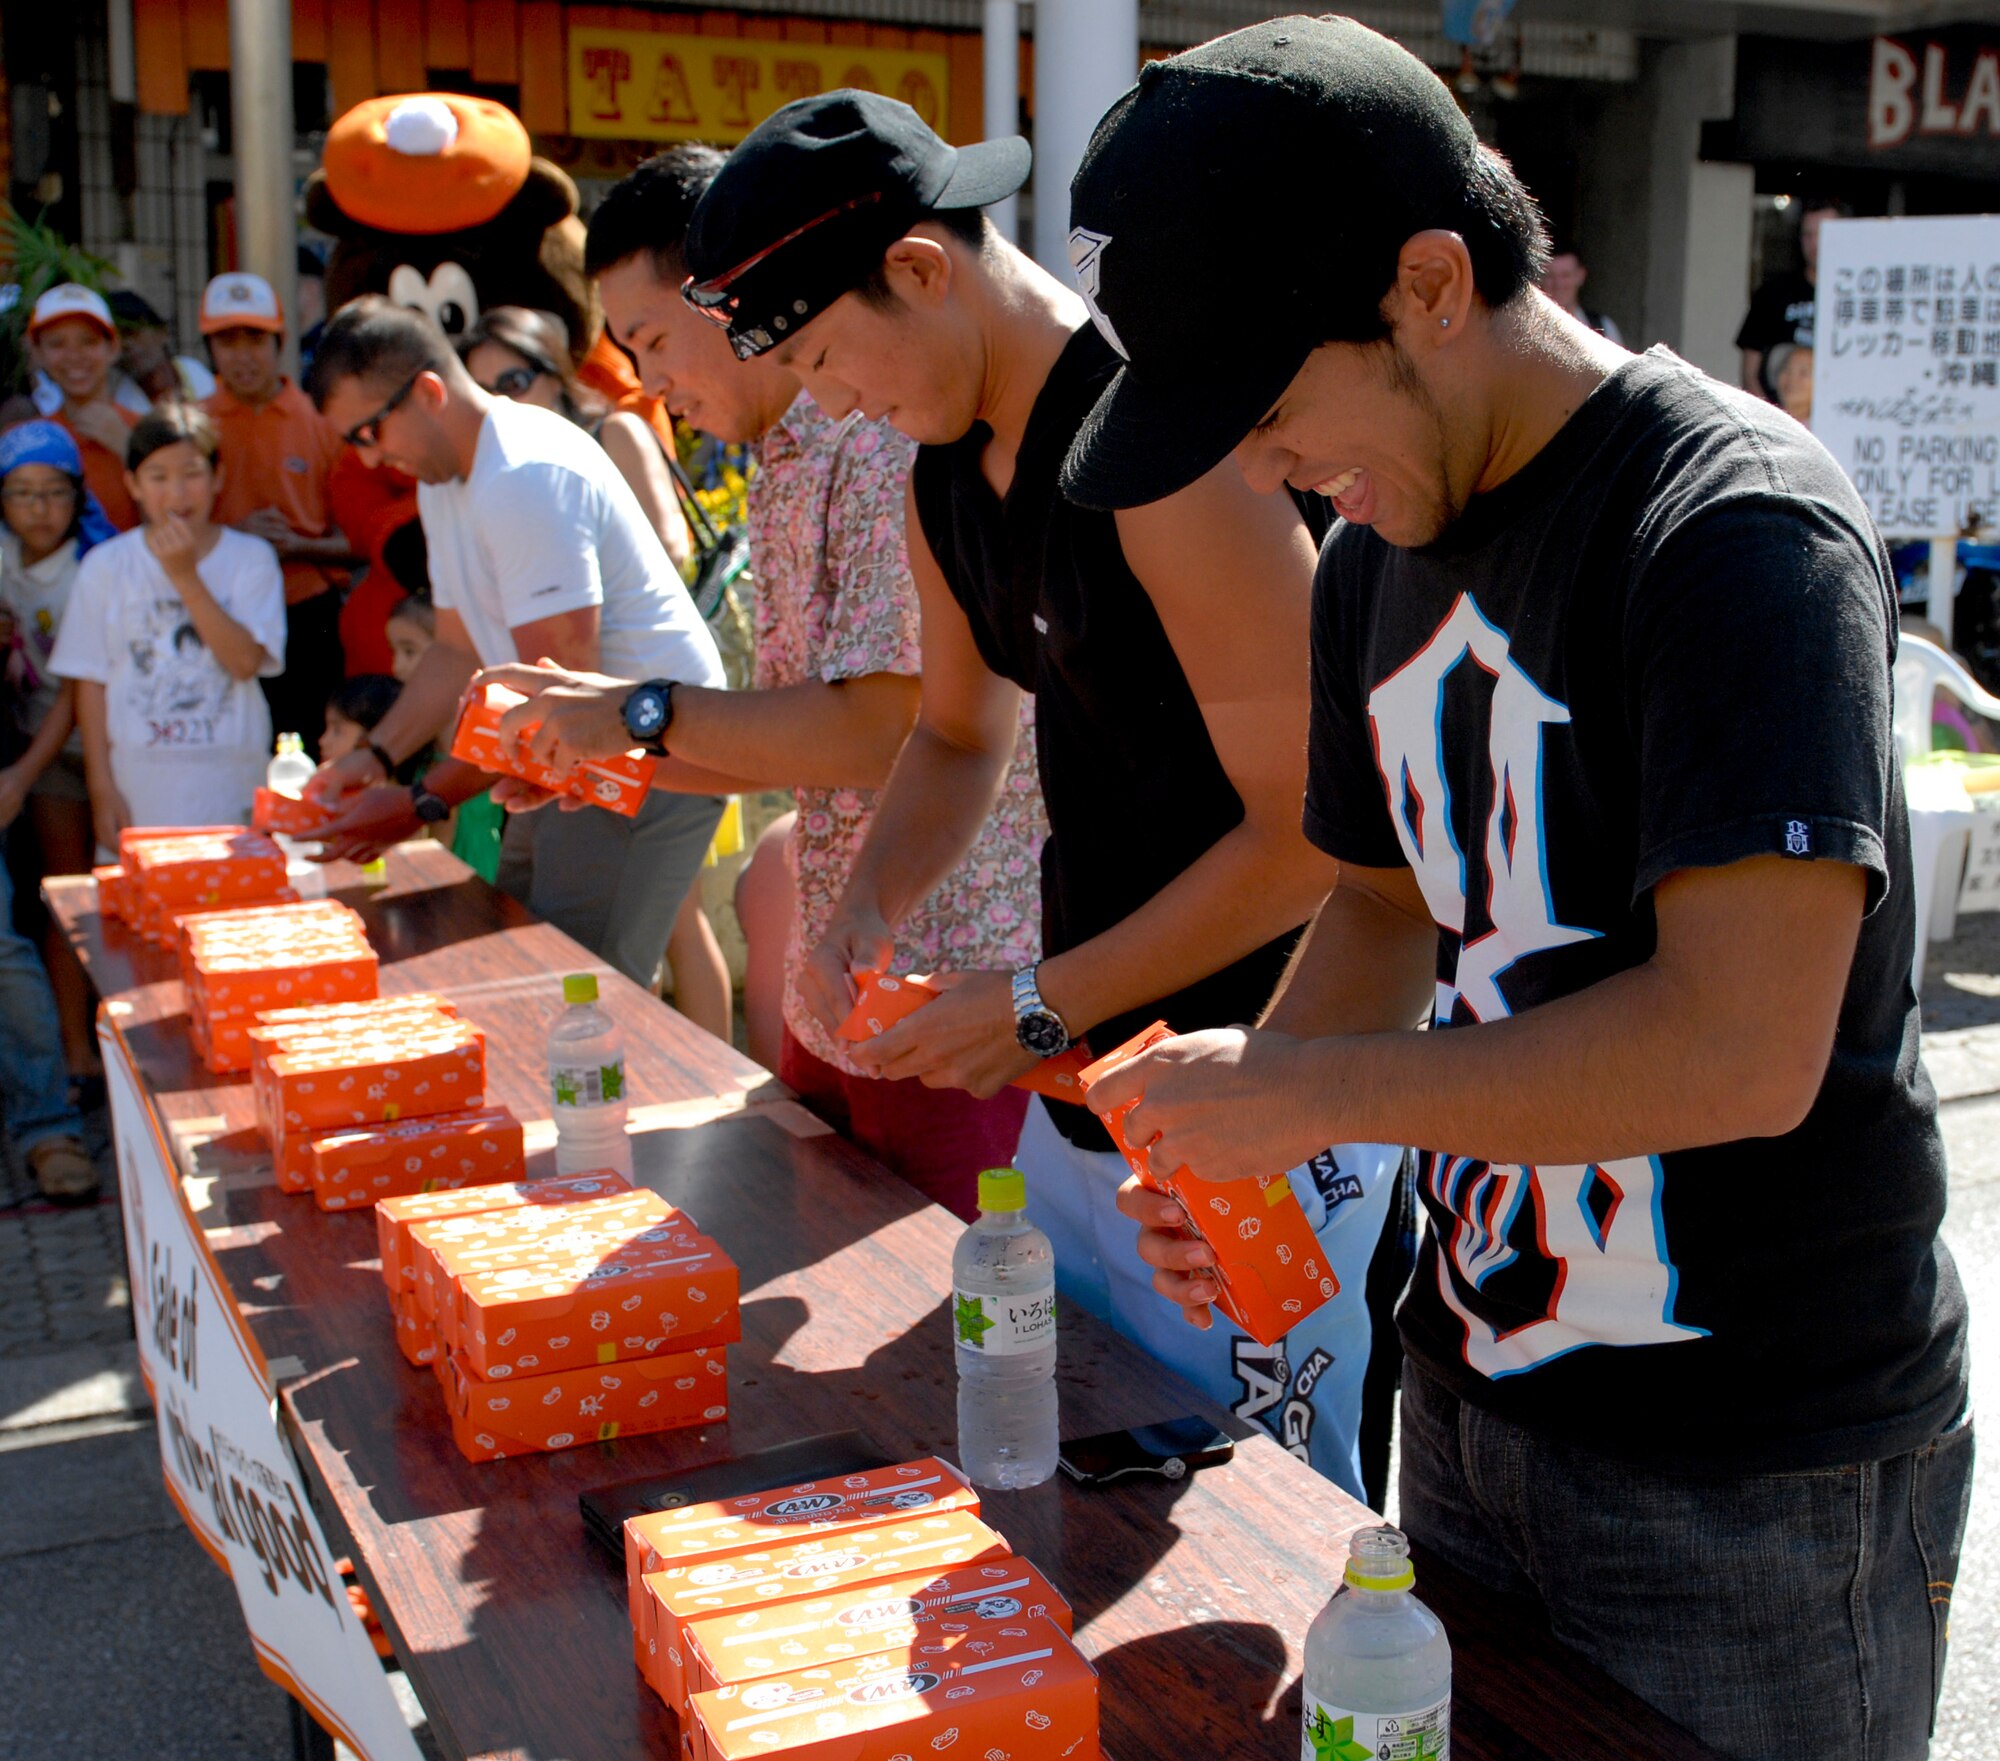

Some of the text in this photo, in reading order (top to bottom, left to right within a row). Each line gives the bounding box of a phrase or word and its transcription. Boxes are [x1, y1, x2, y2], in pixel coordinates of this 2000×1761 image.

[1855, 435, 1998, 464] NO PARKING
[1854, 467, 1912, 495] ONLY
[1929, 466, 1974, 494] FOR
